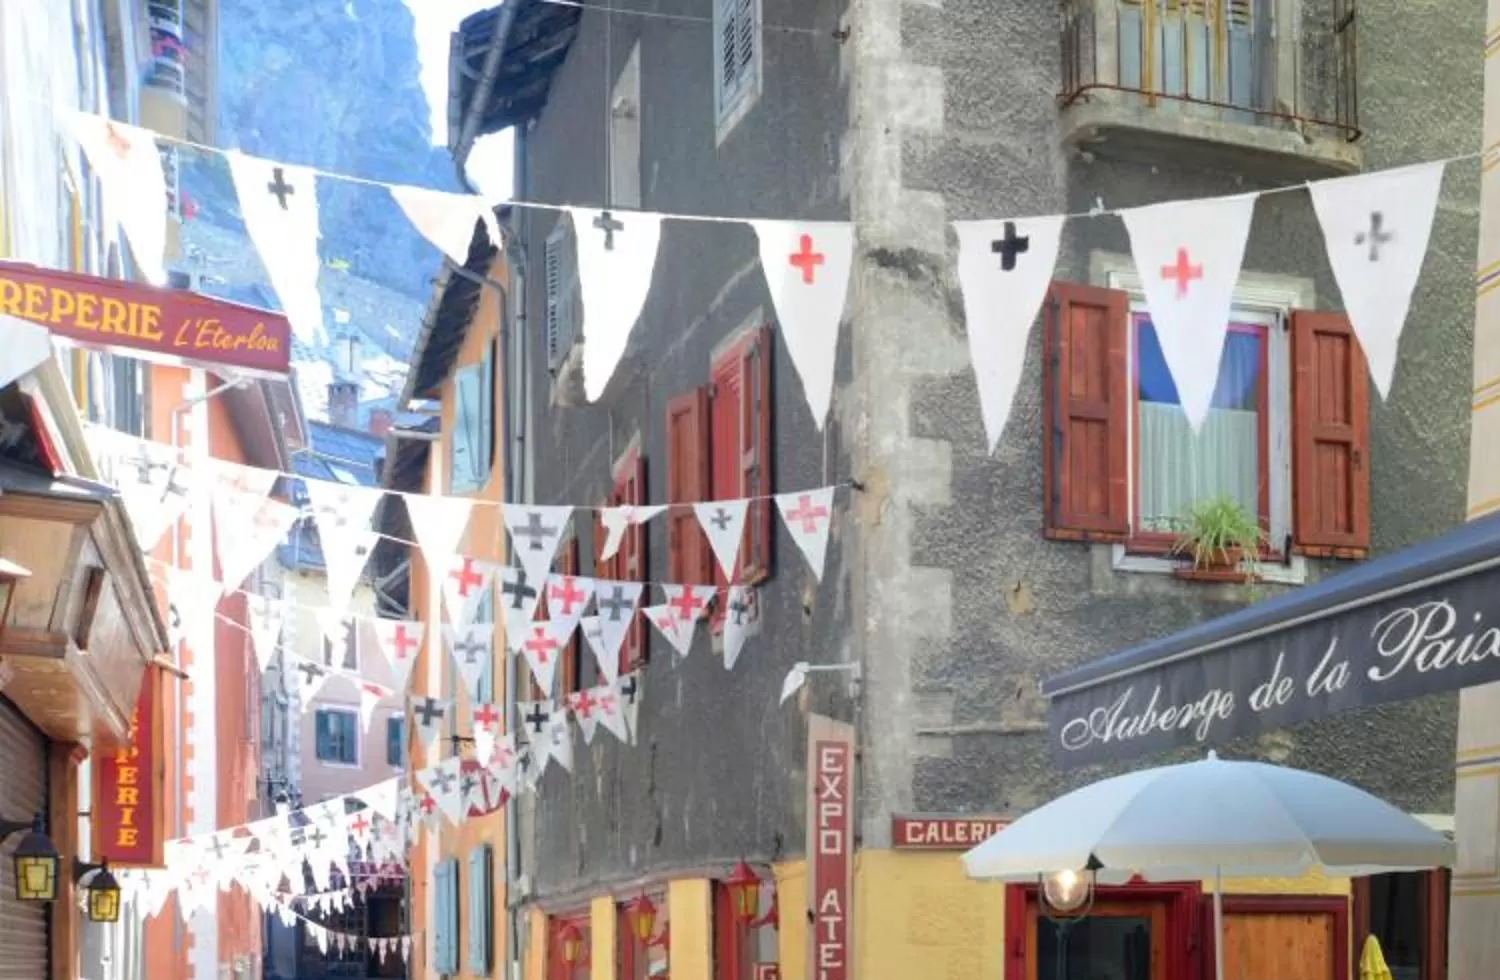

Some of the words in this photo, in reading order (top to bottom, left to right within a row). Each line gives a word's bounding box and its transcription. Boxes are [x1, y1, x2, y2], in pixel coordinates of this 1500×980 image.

[0, 277, 163, 341] REPERIE
[174, 317, 280, 352] L'Eterlou
[1060, 683, 1235, 752] Auberge
[1248, 651, 1296, 712] de
[1306, 636, 1351, 698] la
[820, 747, 844, 855] EXPO
